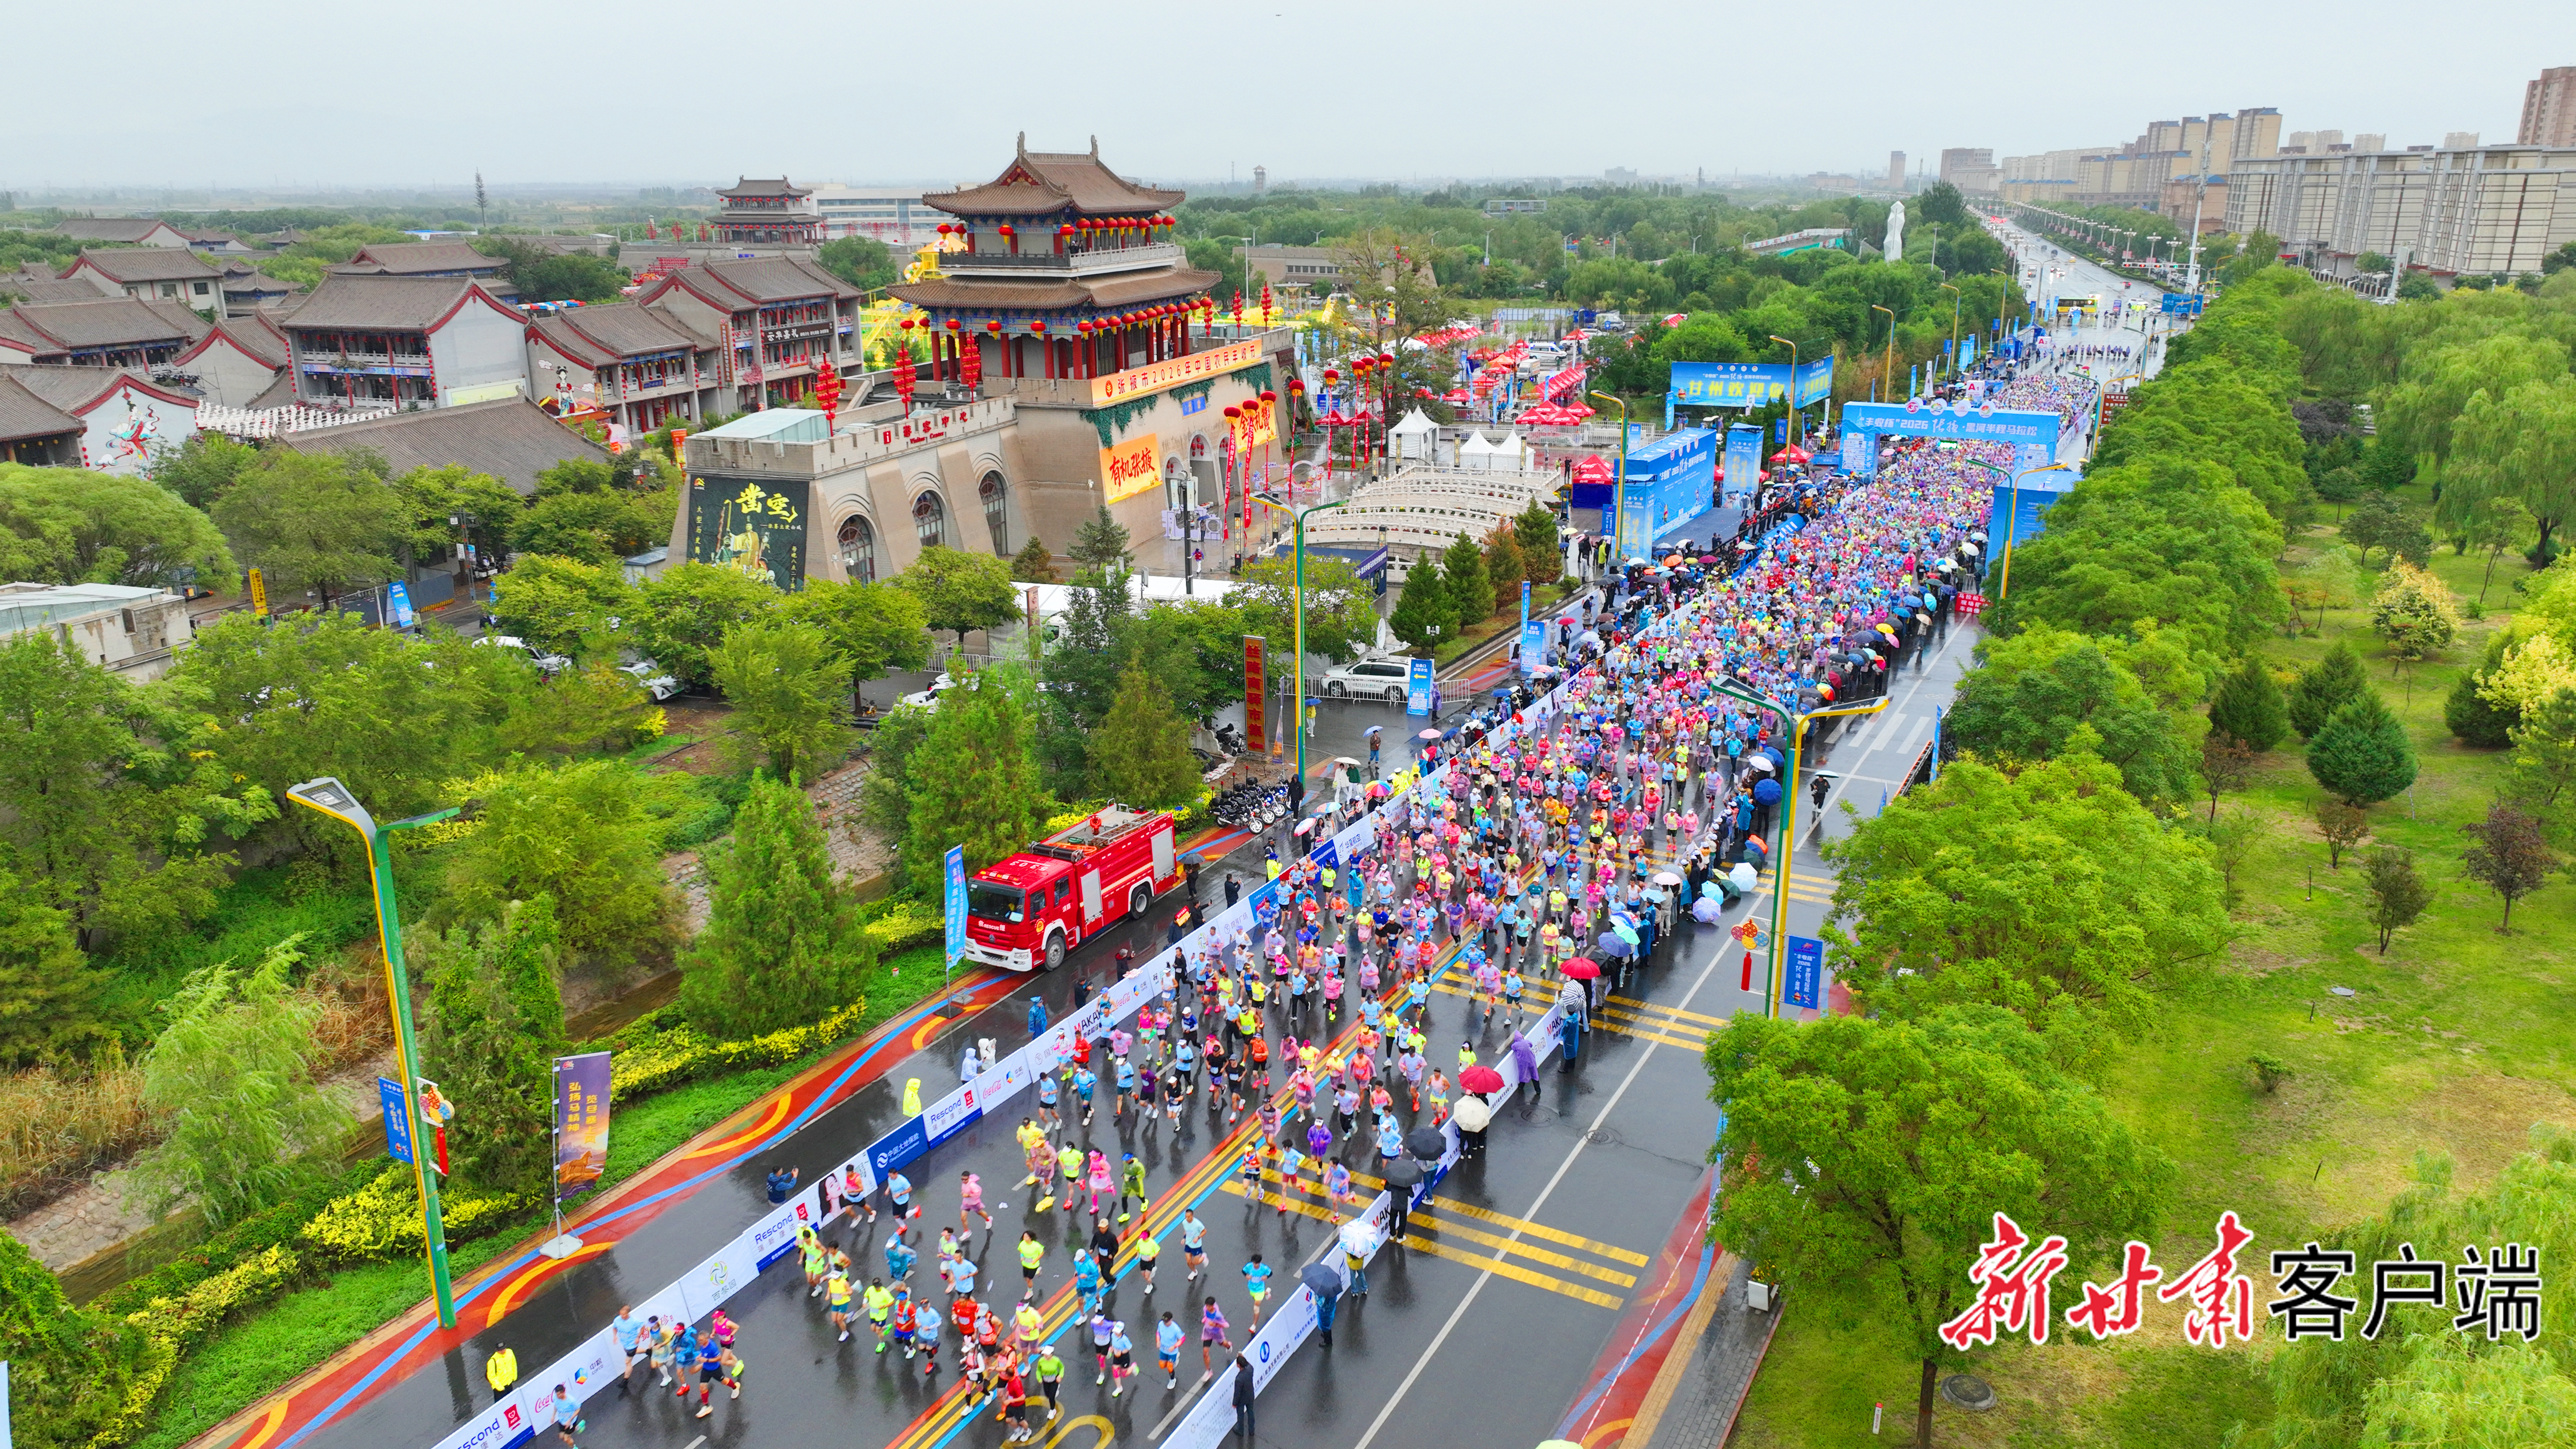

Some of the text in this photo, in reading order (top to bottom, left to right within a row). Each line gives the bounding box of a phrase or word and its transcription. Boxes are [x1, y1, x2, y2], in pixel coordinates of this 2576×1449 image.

[1118, 345, 1255, 394] 张掖市2026年中国农民丰收节
[1688, 380, 1785, 398] 甘州欢迎你
[1109, 447, 1155, 487] 有机张掖
[735, 483, 798, 523] 凿空
[1063, 903, 1070, 913] 消防
[983, 1079, 1002, 1099] Coca-Cola
[567, 1082, 581, 1132] 弘扬马精神
[584, 1094, 598, 1144] 览尽塞上风
[887, 1131, 920, 1158] 中国大地保险
[589, 1358, 603, 1370] 中粮
